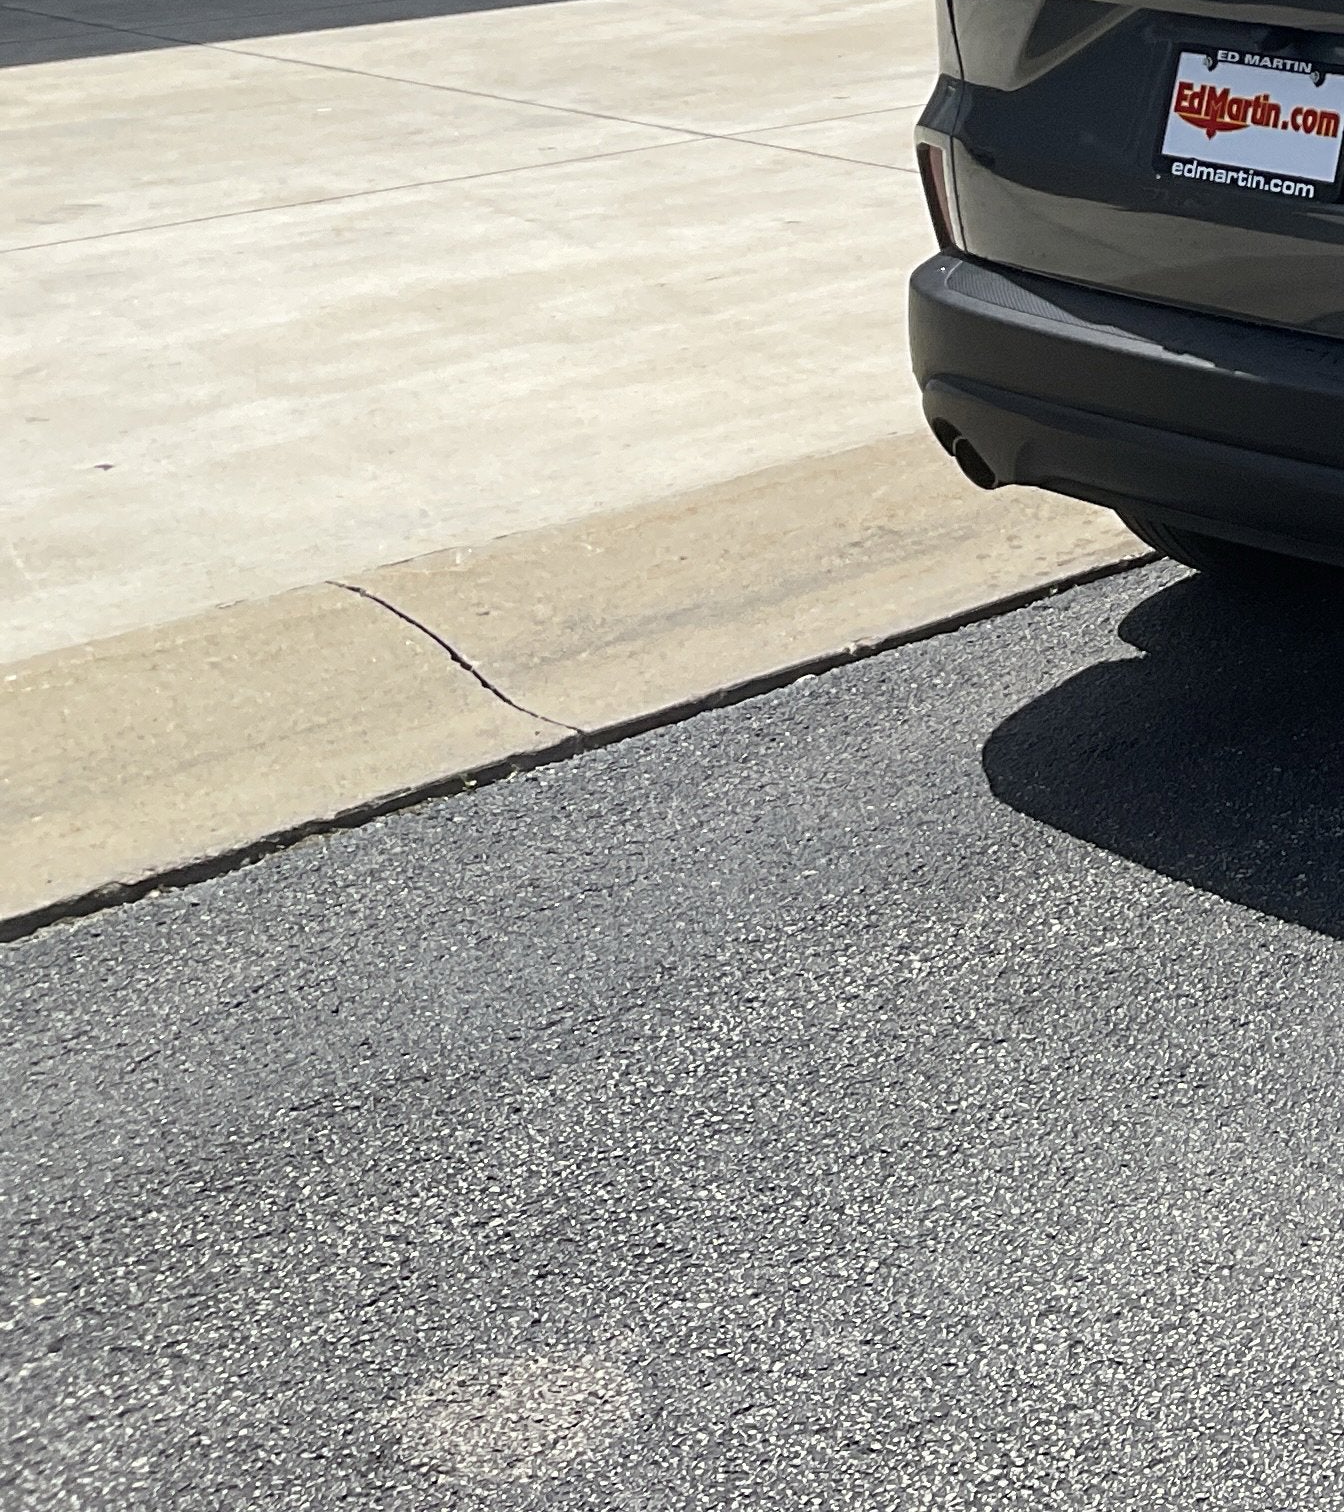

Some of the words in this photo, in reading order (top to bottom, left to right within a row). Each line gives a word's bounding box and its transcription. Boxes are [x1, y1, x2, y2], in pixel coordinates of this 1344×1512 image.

[1217, 50, 1240, 63] ED
[1244, 54, 1313, 74] MARTIN
[1174, 81, 1341, 138] EdMartin.com
[1171, 160, 1315, 199] edmartin.com
